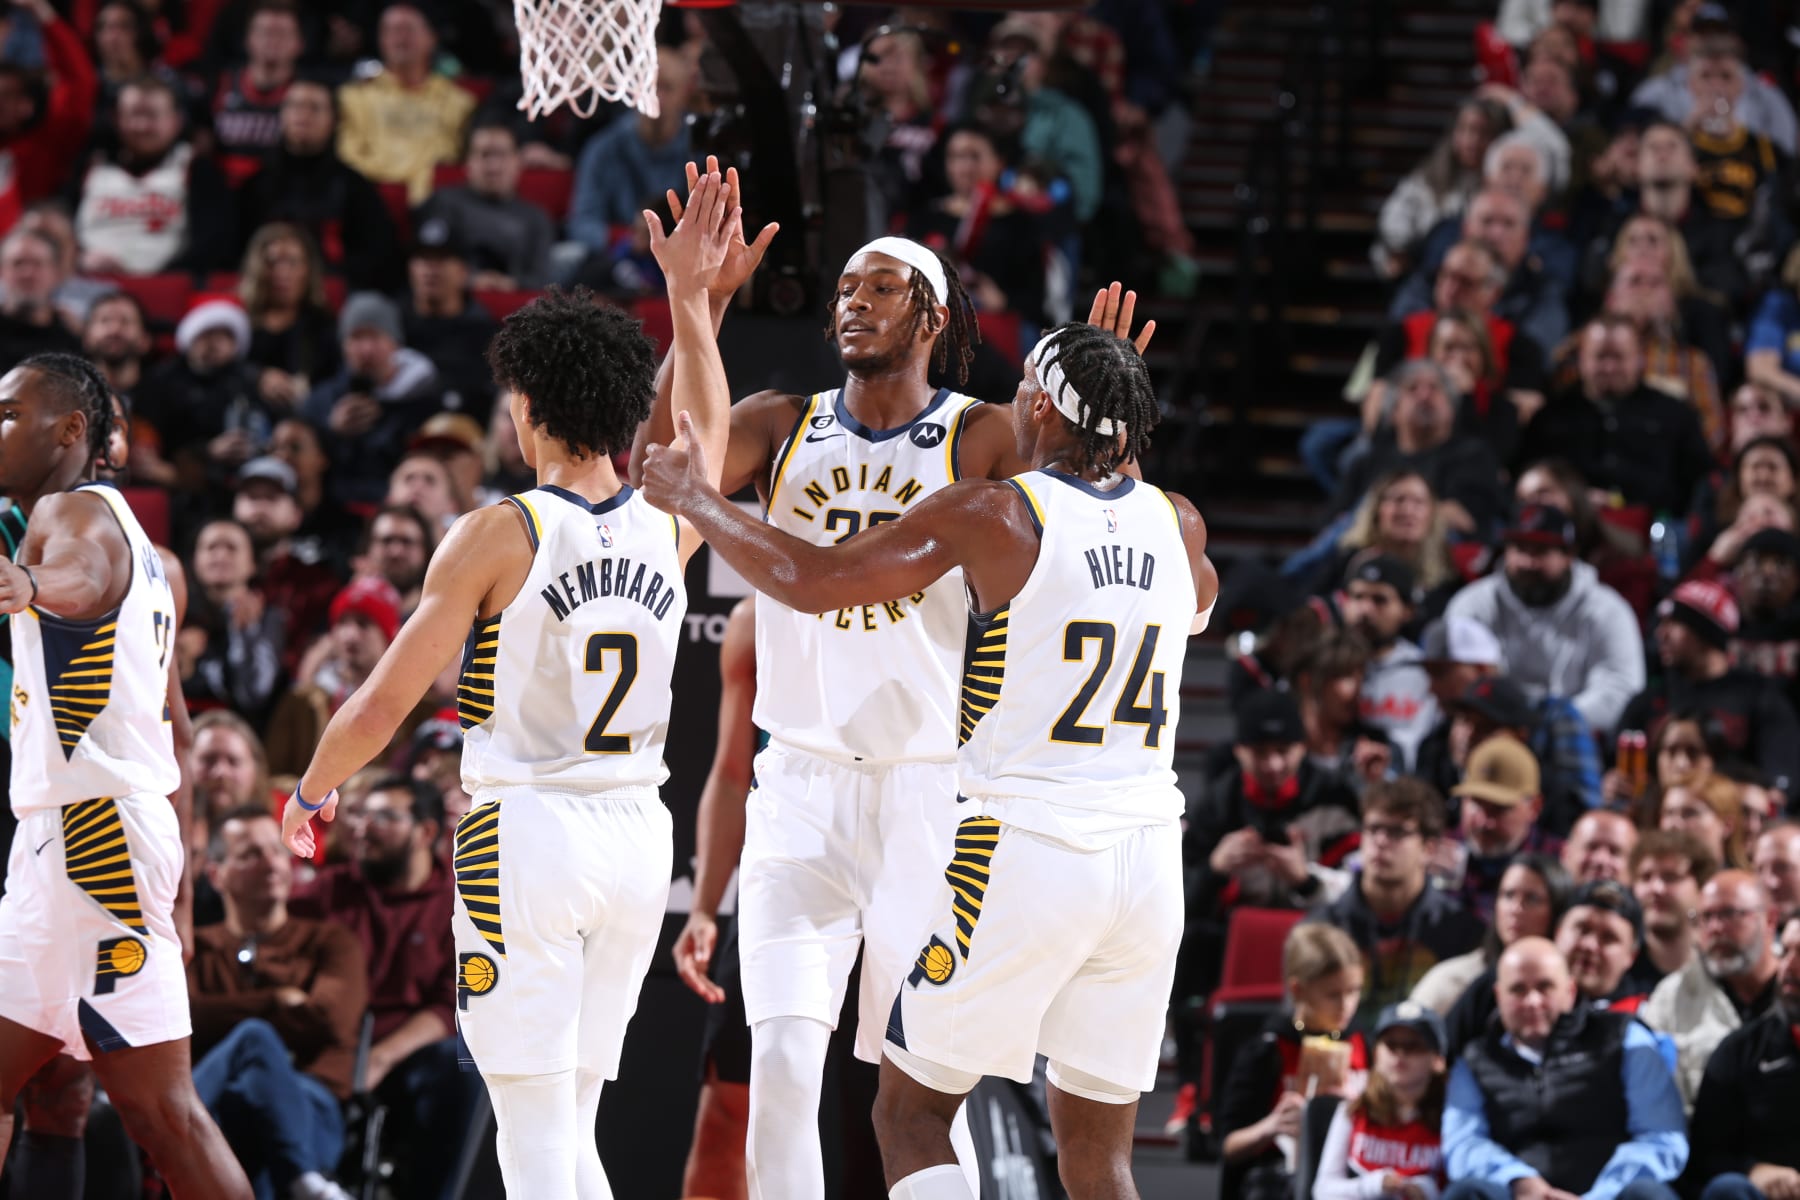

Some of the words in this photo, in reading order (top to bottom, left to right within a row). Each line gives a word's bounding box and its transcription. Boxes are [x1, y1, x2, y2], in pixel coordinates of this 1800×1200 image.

[541, 557, 675, 622] NEMBHARD
[1084, 545, 1156, 591] HIELD
[582, 630, 639, 754] 2
[1048, 618, 1168, 750] 24
